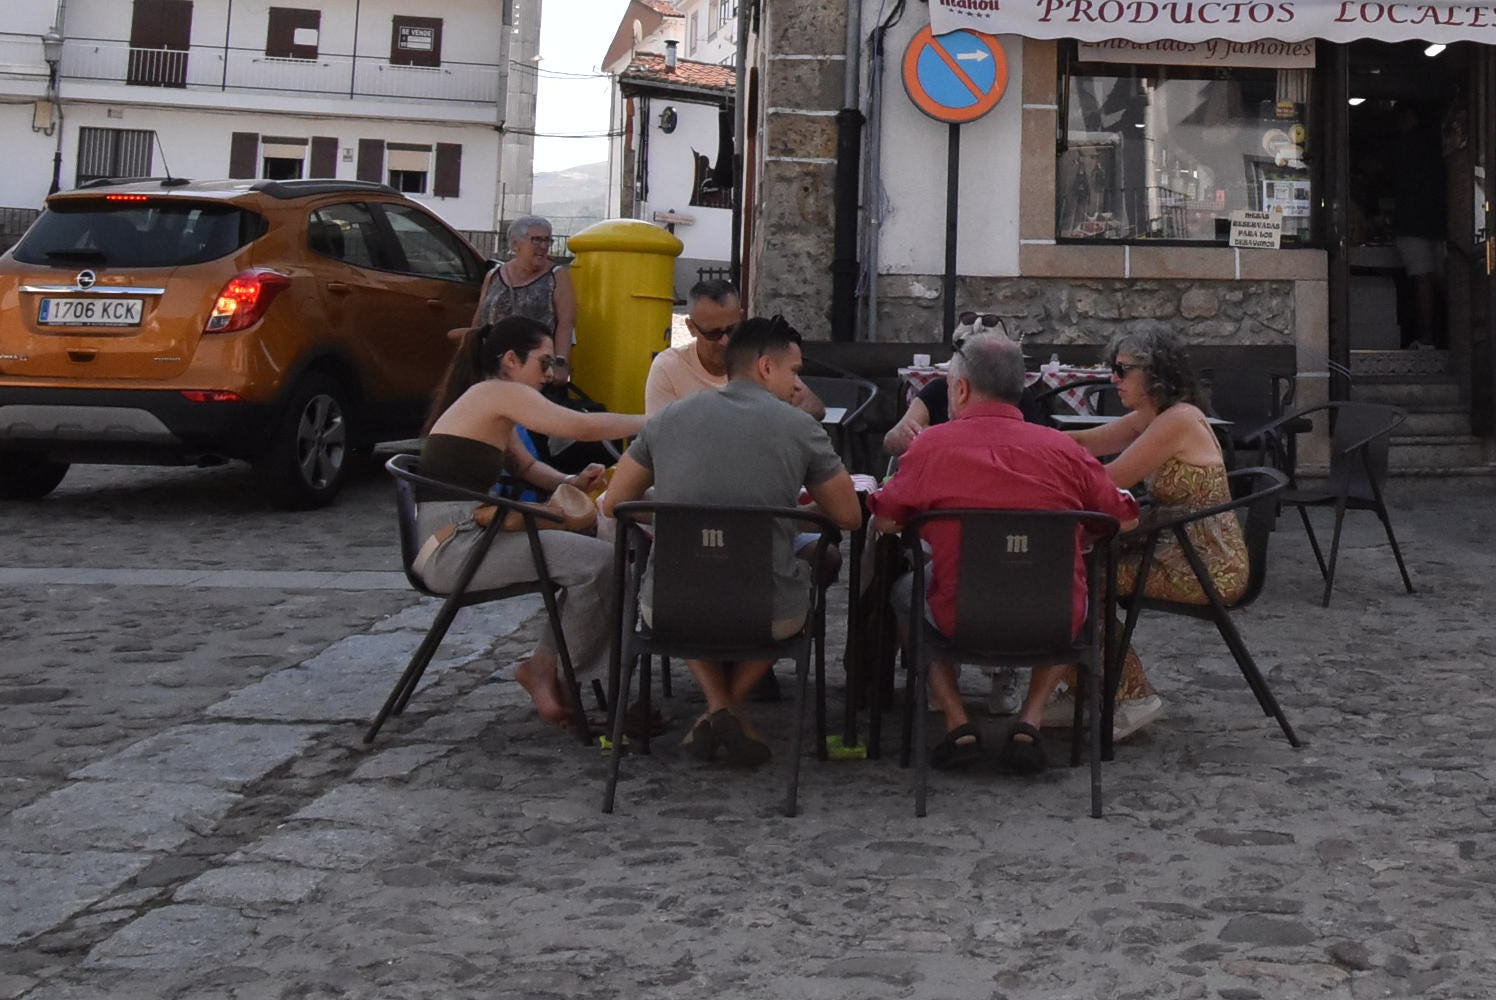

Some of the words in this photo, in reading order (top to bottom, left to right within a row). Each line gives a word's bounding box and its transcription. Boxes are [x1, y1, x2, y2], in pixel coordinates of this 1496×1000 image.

[1232, 221, 1280, 230] RESERVADAS
[1238, 230, 1258, 238] PARA
[53, 301, 96, 319] 1706
[101, 302, 136, 320] KCK
